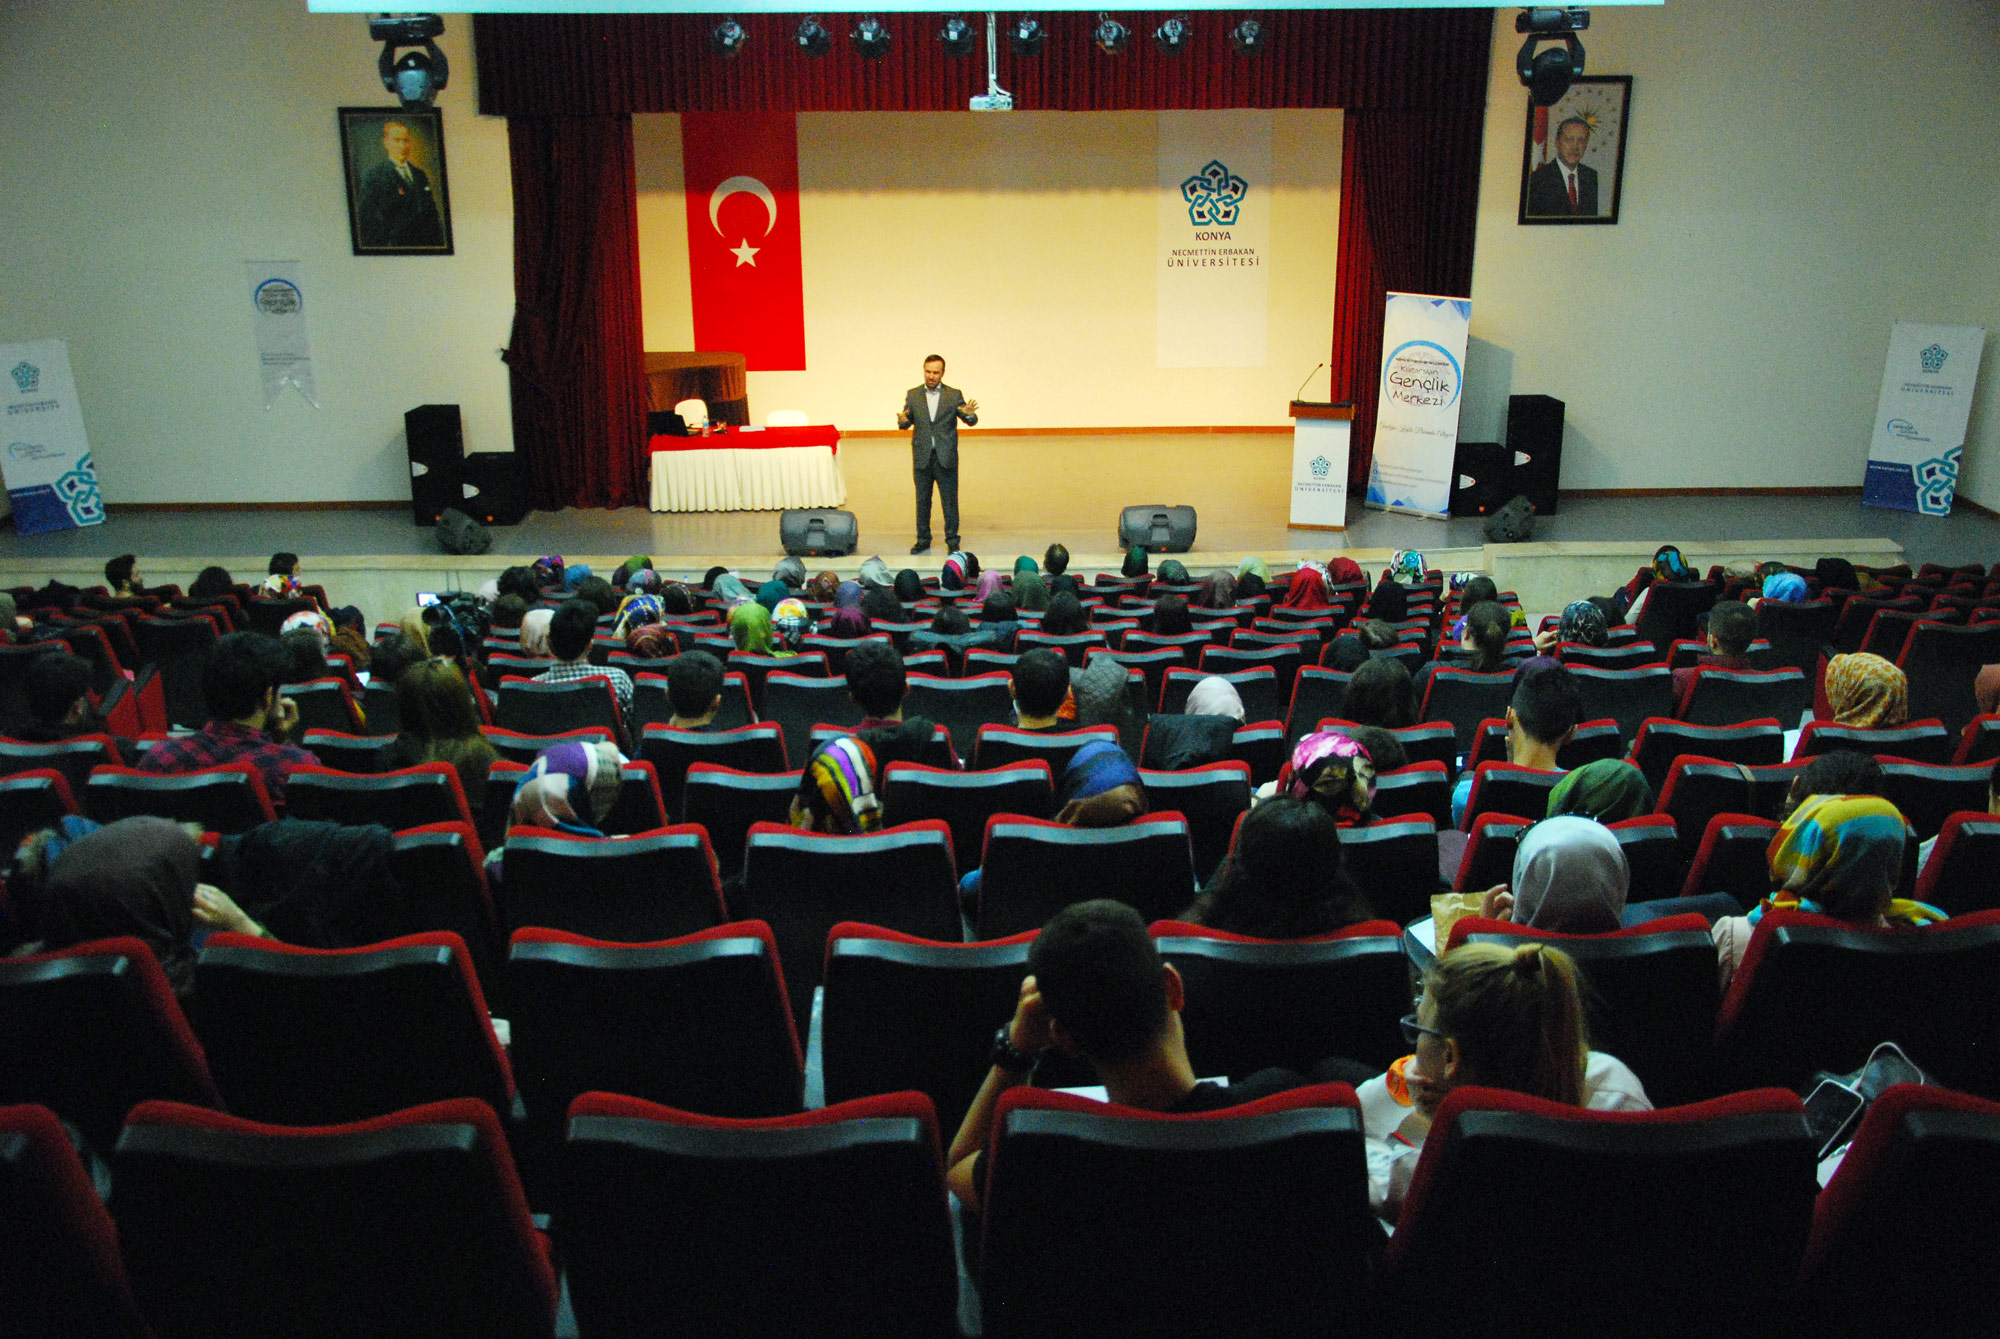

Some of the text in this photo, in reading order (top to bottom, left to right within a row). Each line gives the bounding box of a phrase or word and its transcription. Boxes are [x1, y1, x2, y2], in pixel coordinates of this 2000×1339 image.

[1195, 231, 1232, 241] KONYA
[1172, 247, 1255, 256] NECMETTİN ERBAKAN
[1167, 256, 1260, 268] ÜNİVERSİTESİ
[1389, 371, 1450, 393] Gençlik
[1392, 390, 1443, 406] Merkezi
